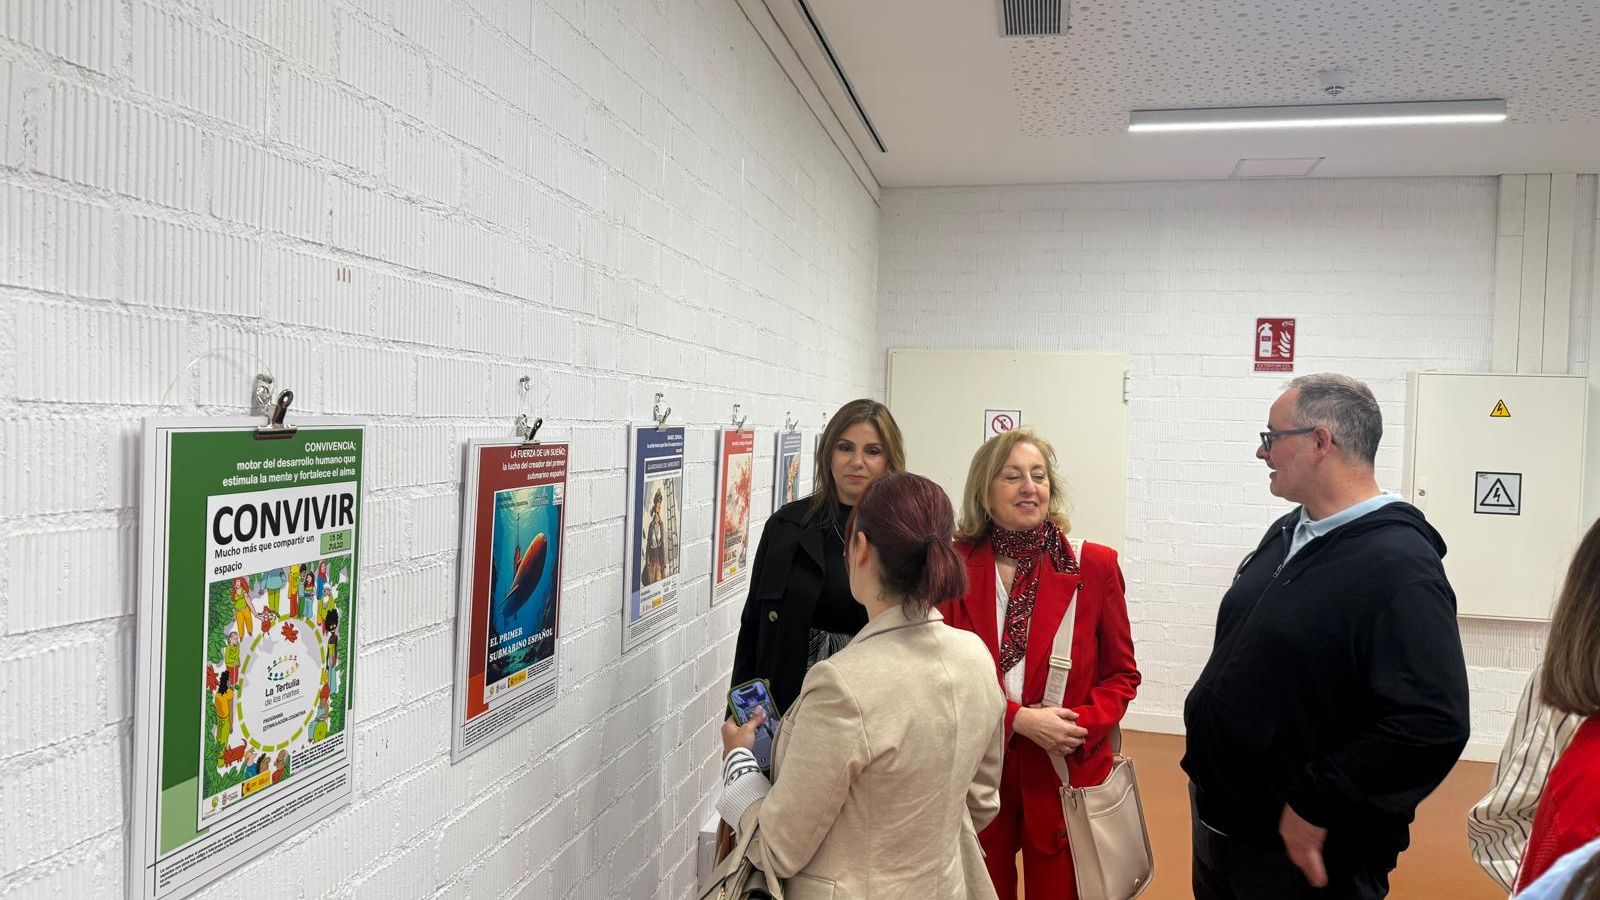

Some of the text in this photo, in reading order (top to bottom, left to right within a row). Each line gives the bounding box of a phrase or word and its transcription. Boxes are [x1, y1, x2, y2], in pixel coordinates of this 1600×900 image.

[511, 450, 516, 459] LA
[518, 449, 536, 458] FUERZA
[537, 449, 543, 457] DE
[237, 456, 356, 471] motor del desarrollo humano que
[503, 462, 507, 470] la
[508, 461, 520, 470] lucha
[529, 460, 545, 469] creador
[553, 459, 565, 468] primer
[223, 467, 355, 487] estimula la mente y fortalece el alma
[528, 469, 565, 480] submarino español
[213, 493, 354, 545] CONVIVIR
[214, 535, 315, 559] Mucho más que compartir un
[214, 562, 242, 575] espacio
[489, 628, 553, 663] SUBMARINO ESPAÑOL
[490, 627, 523, 648] EL PRIMER
[265, 679, 300, 697] La Tertulia
[265, 689, 300, 706] de los martes
